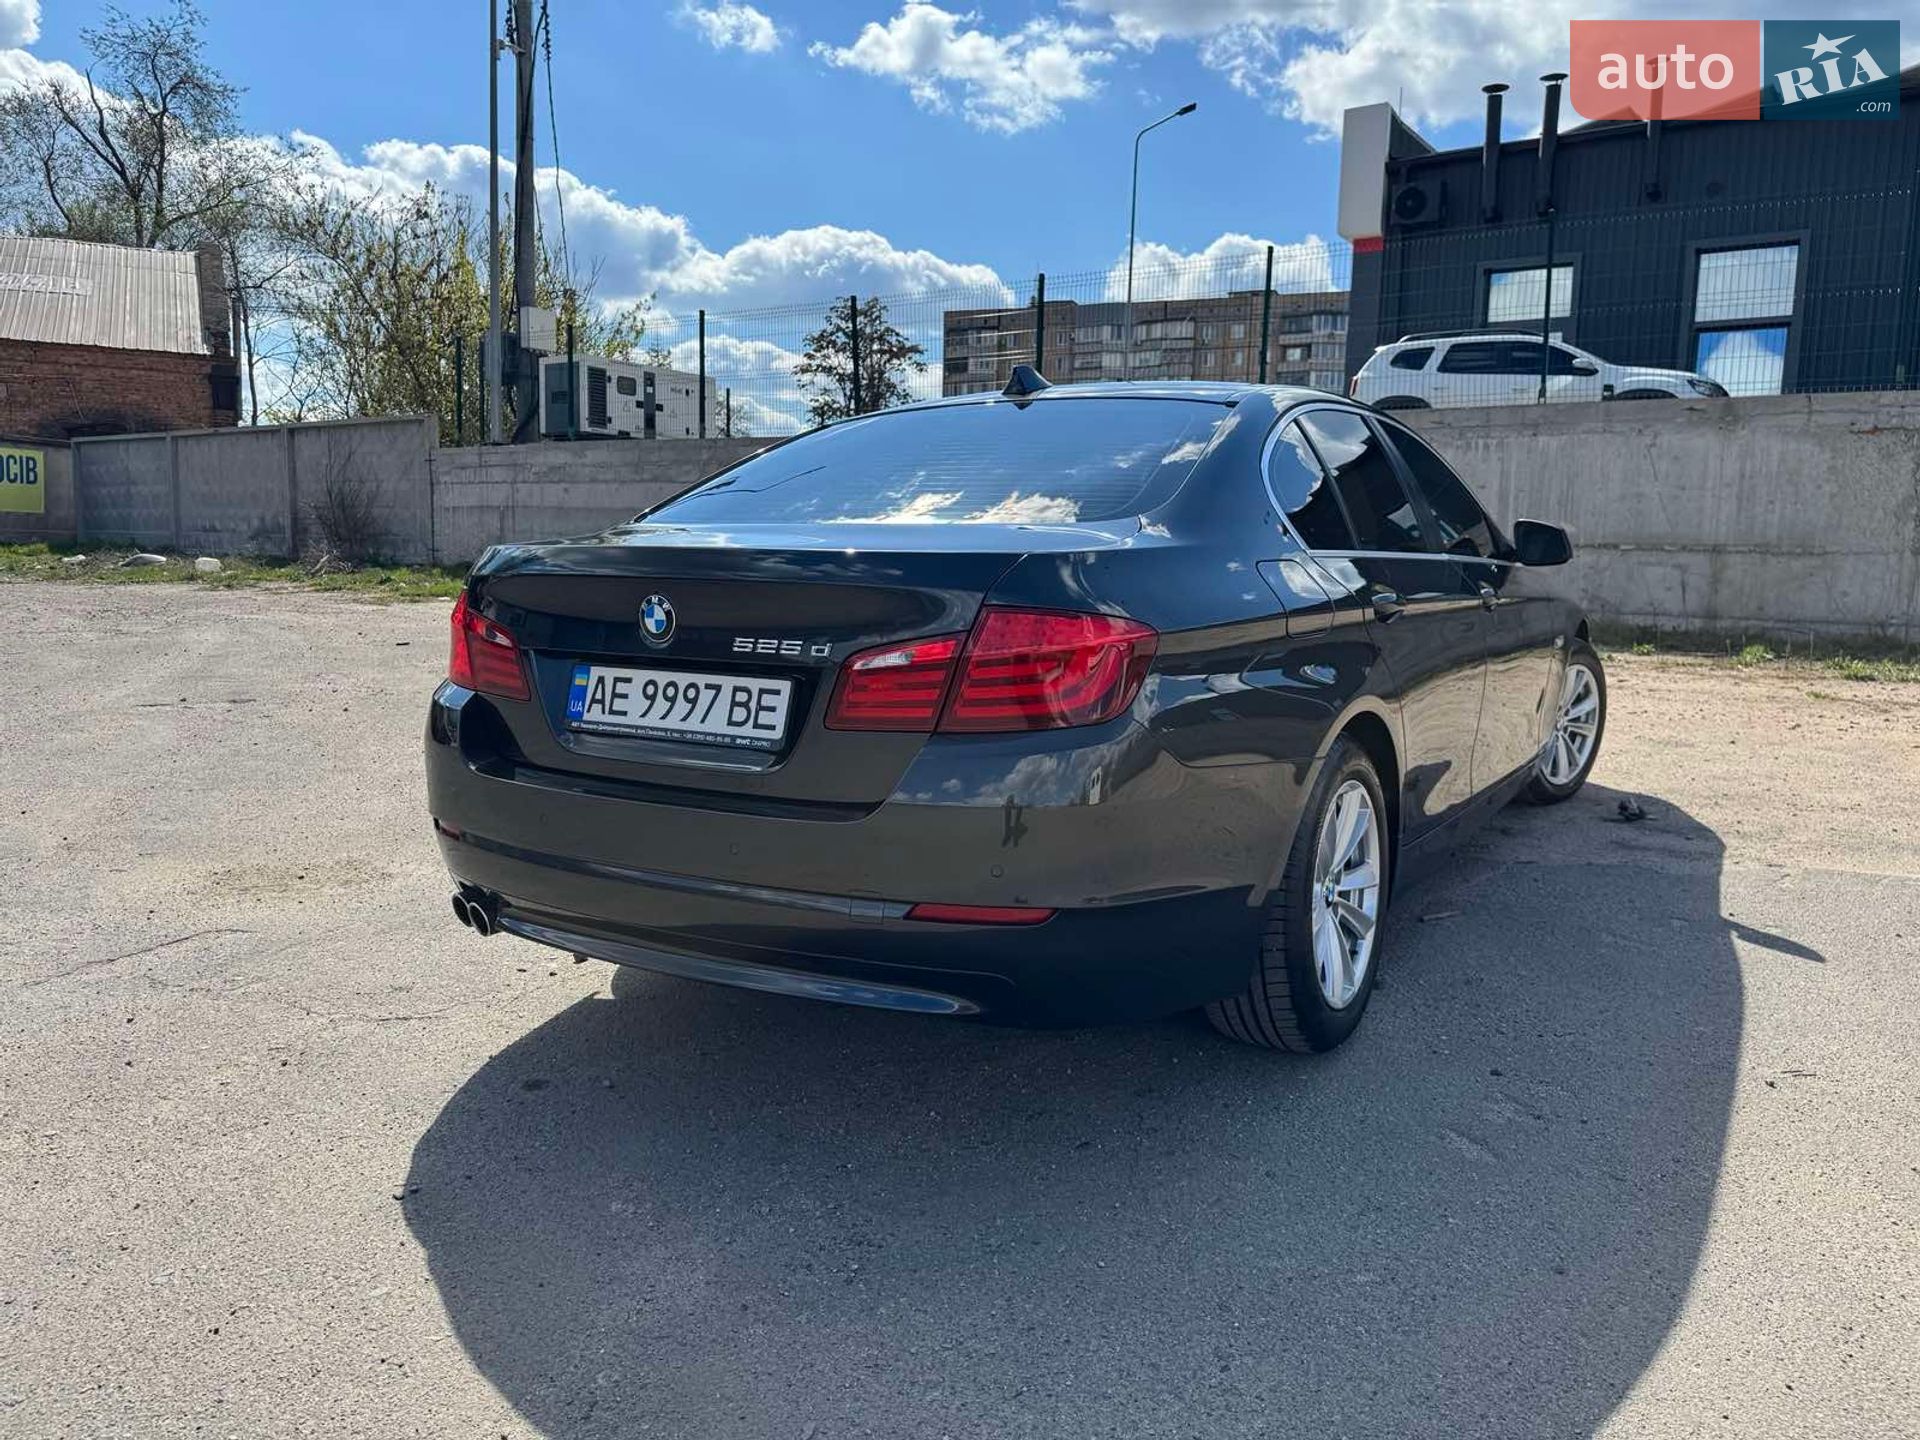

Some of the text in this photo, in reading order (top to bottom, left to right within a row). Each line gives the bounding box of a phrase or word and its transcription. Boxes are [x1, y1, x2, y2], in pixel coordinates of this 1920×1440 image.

[732, 637, 833, 657] 525 d
[570, 700, 583, 713] UA
[586, 675, 782, 731] AE 9997 BE
